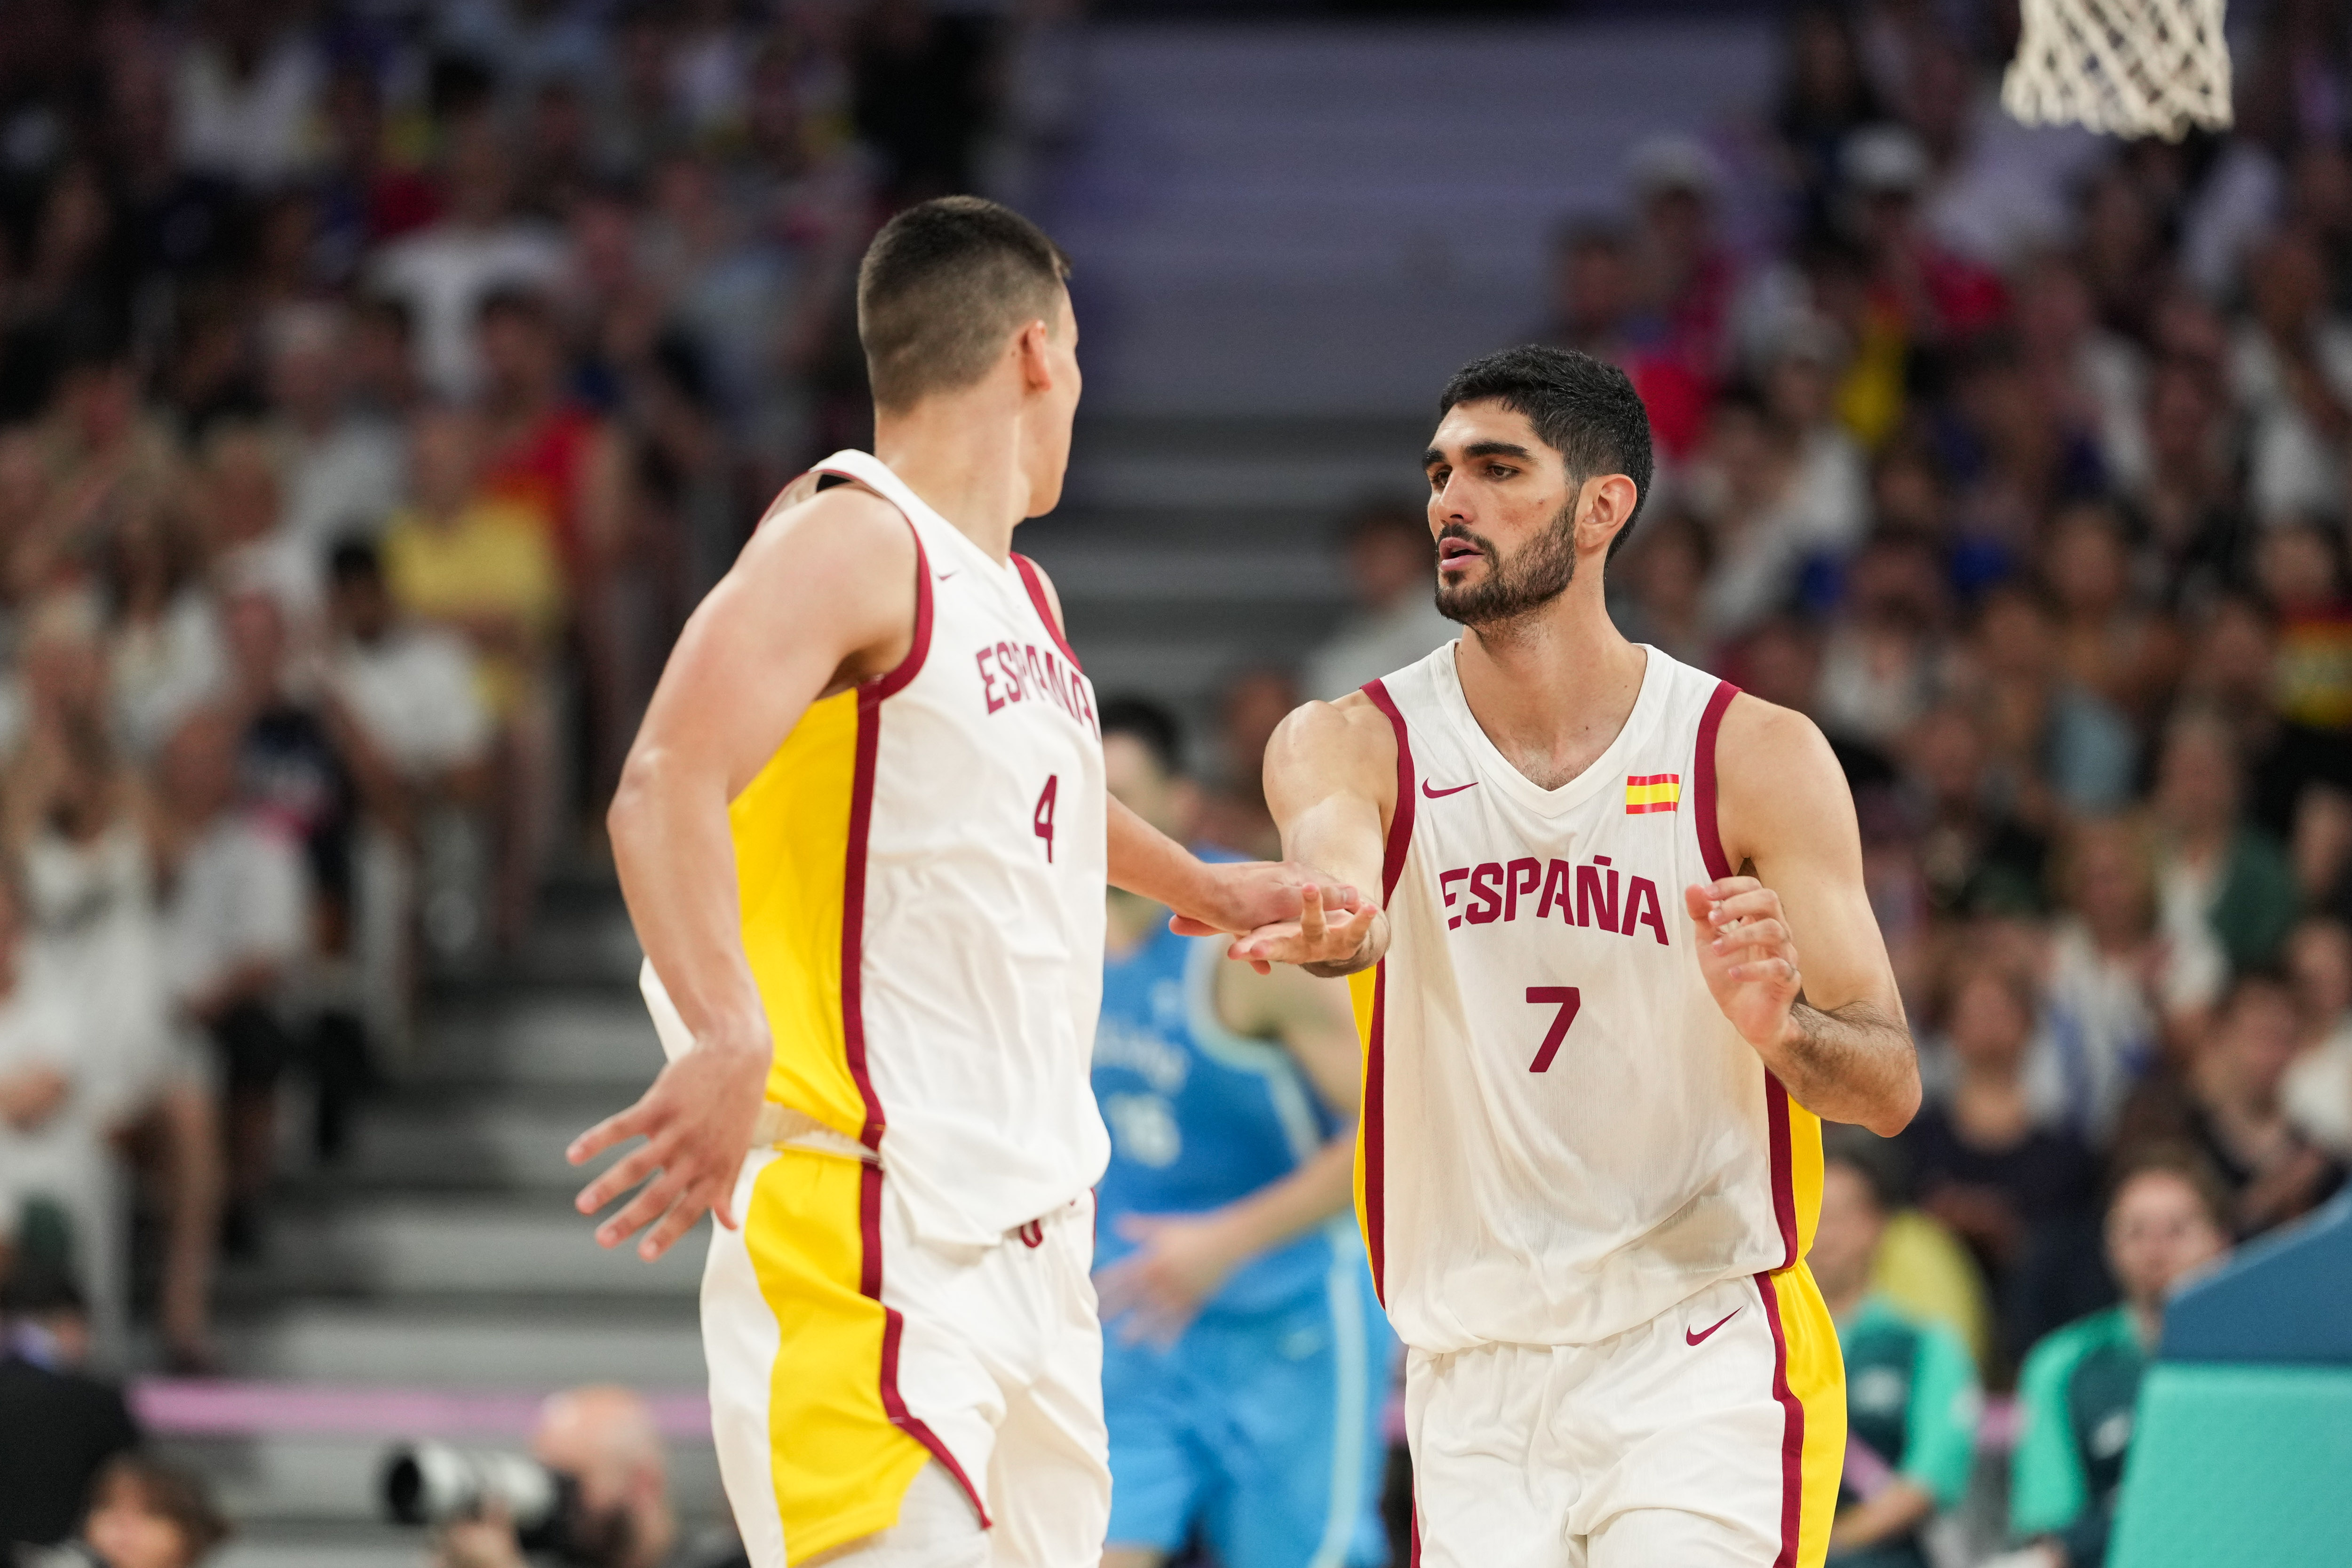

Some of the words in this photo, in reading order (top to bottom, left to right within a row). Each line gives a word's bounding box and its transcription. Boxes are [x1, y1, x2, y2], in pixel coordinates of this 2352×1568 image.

[1034, 774, 1057, 863] 4
[1439, 855, 1669, 946] ESPAÑA
[1526, 987, 1581, 1073] 7
